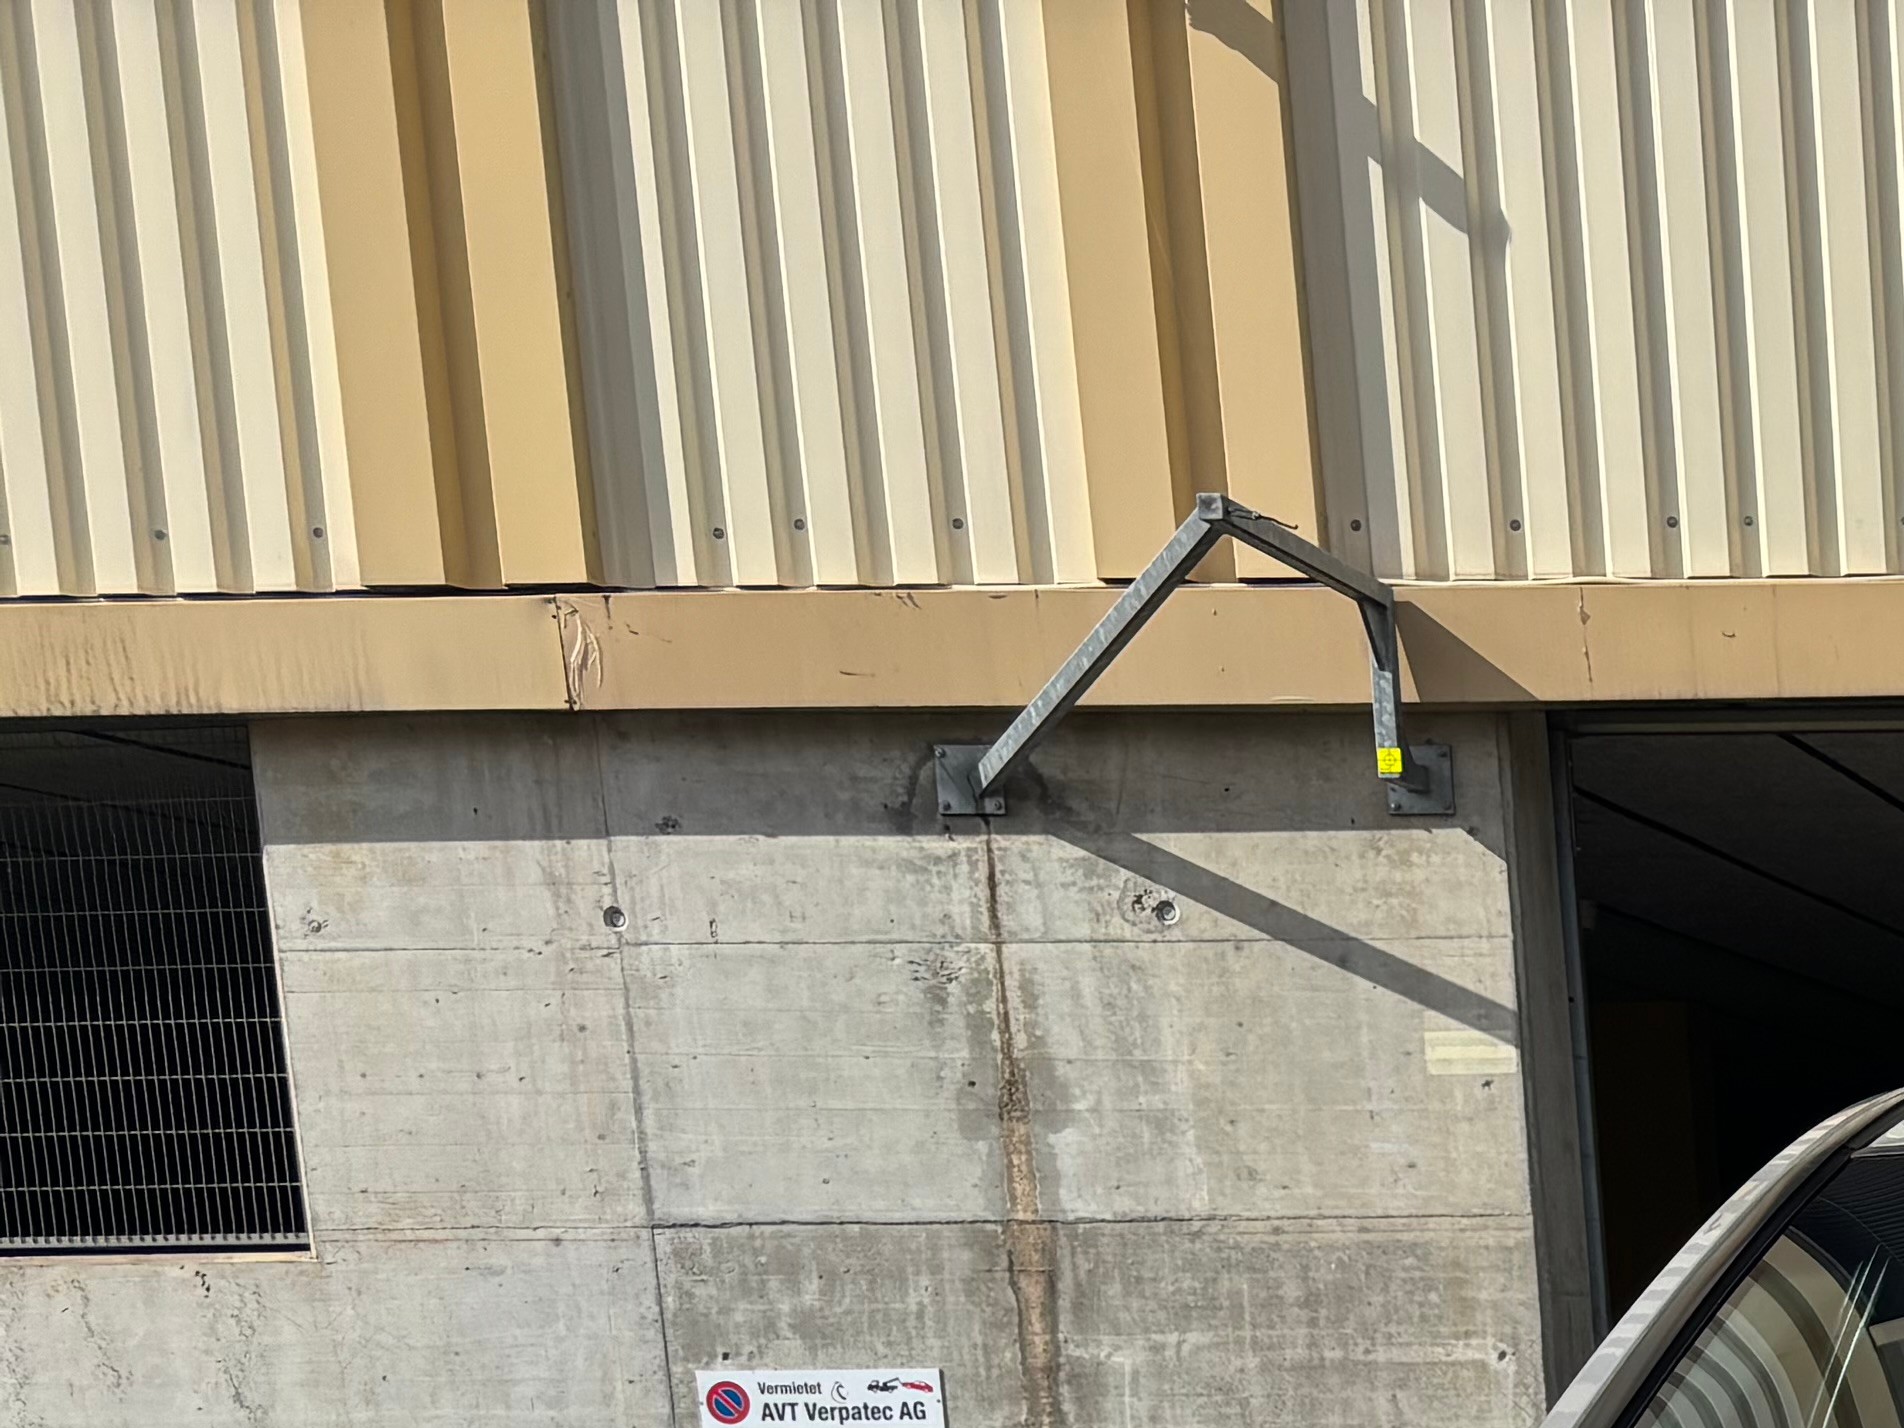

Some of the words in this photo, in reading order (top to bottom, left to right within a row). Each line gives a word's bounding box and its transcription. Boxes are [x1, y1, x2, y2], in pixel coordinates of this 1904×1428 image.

[757, 1381, 822, 1395] Vermietet
[761, 1402, 799, 1421] AVT
[804, 1402, 893, 1425] Verpatec
[899, 1401, 927, 1420] AG
